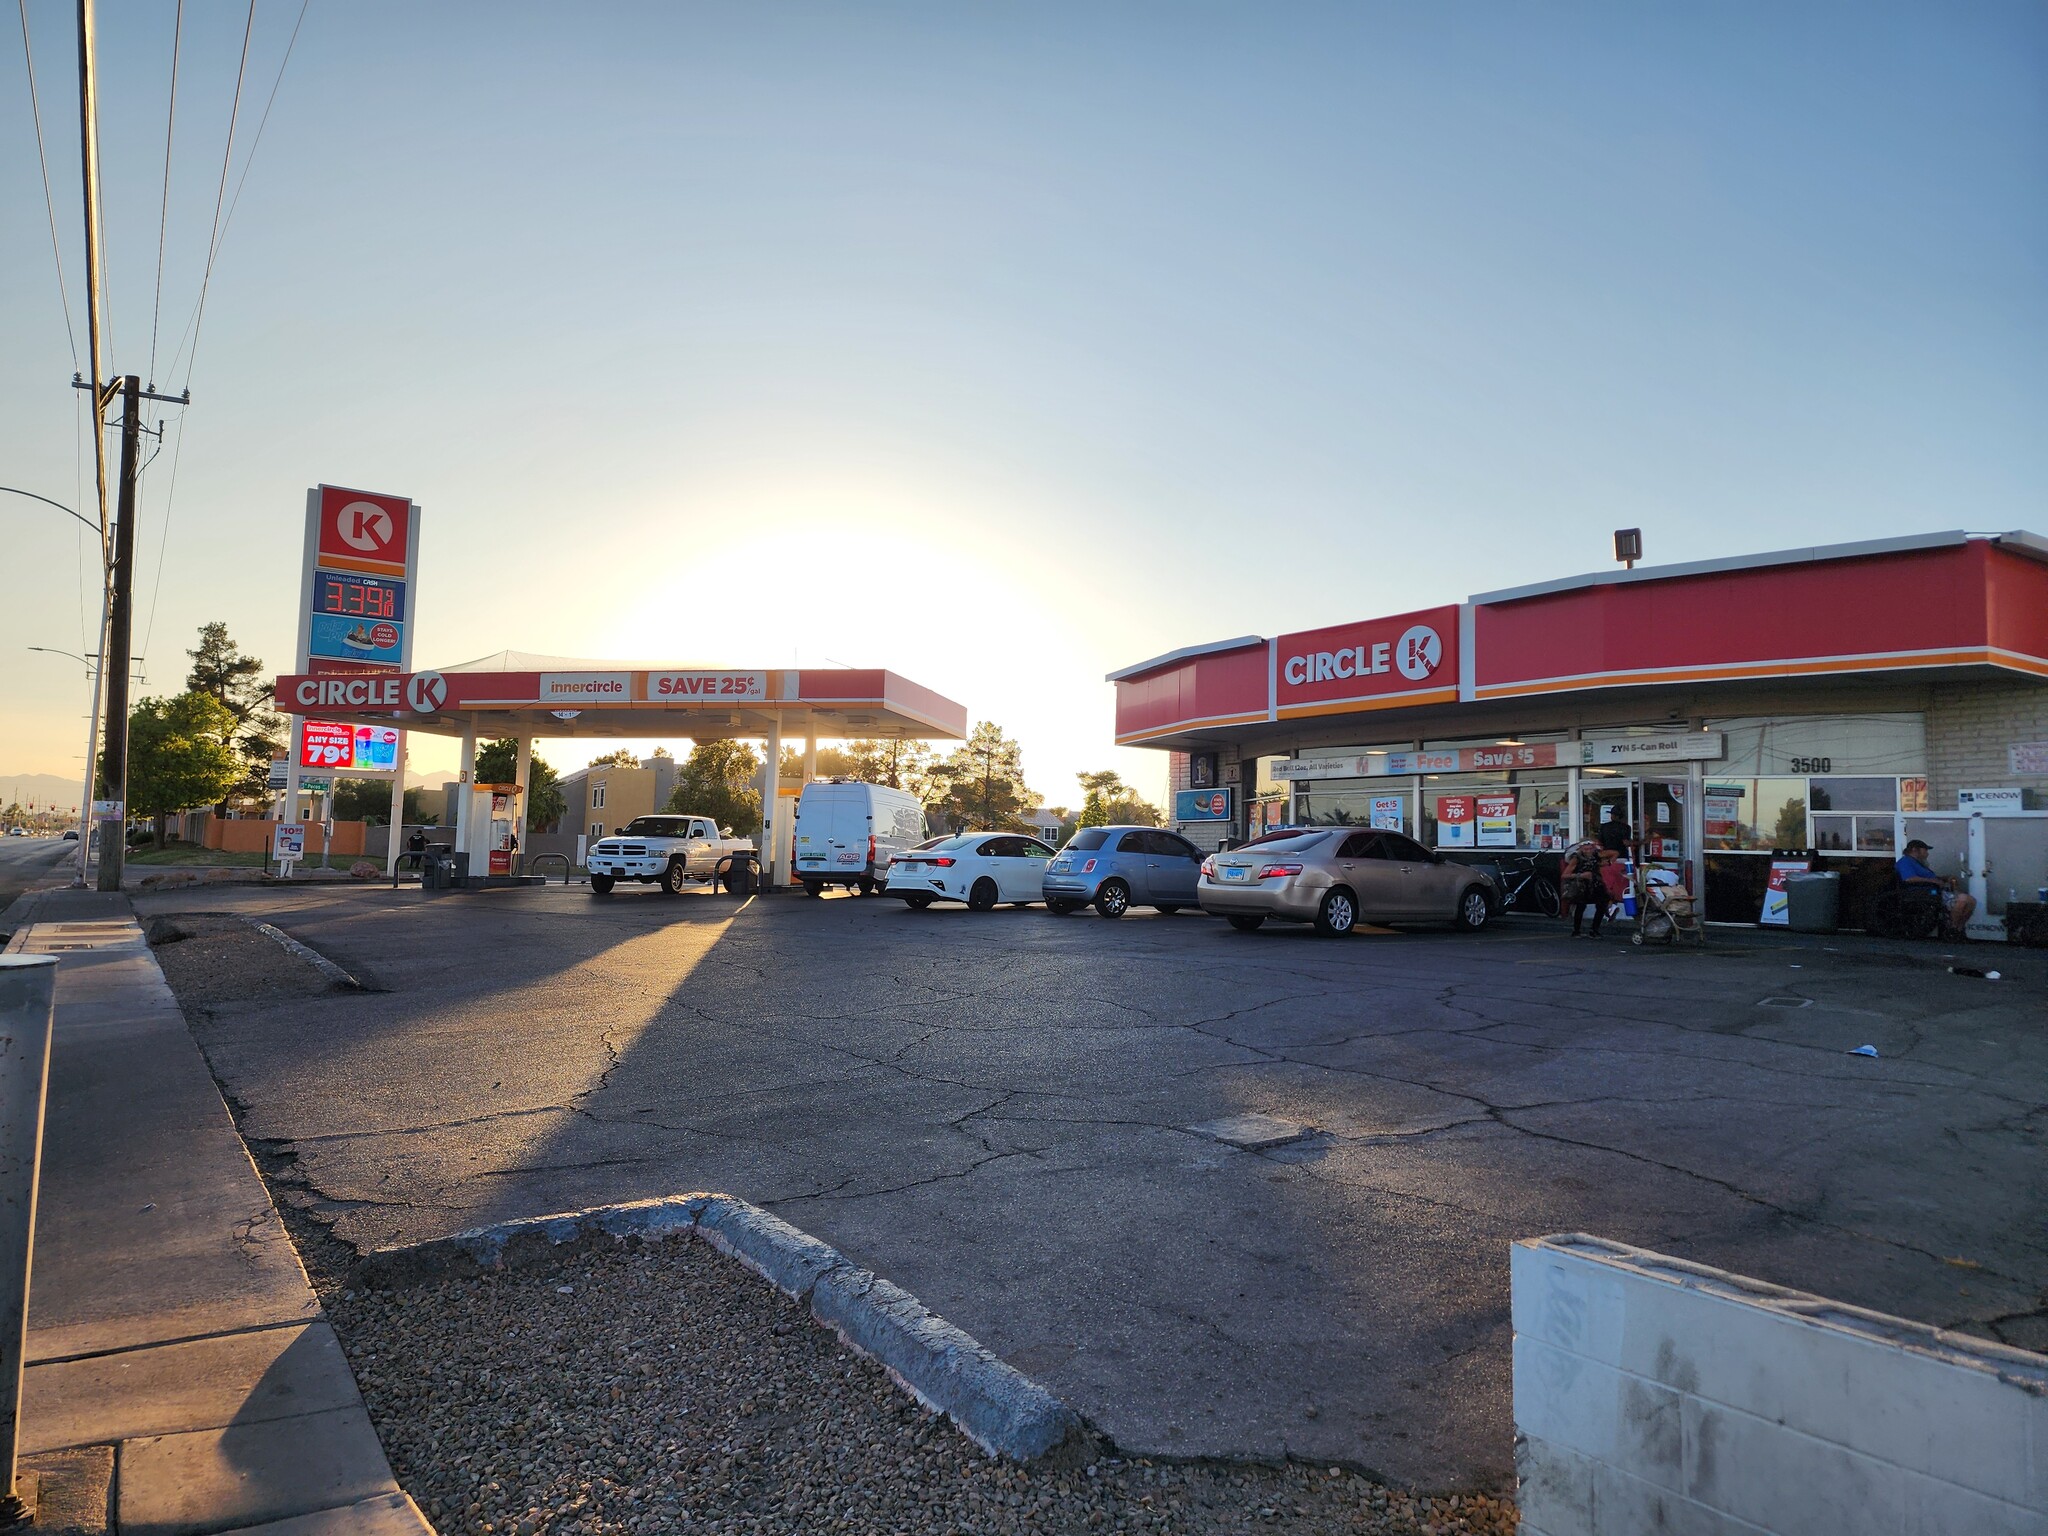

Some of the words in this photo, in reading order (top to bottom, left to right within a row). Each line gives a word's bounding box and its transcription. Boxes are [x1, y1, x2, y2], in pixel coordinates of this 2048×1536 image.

[352, 511, 388, 550] K
[326, 574, 361, 584] Unleaded
[363, 579, 378, 587] CASH
[326, 582, 383, 616] 3.39
[1284, 642, 1391, 686] CIRCLE
[1407, 634, 1438, 672] K
[551, 680, 623, 693] innercircle
[657, 677, 717, 695] SAVE
[720, 675, 755, 695] 25¢
[296, 679, 401, 706] CIRCLE
[416, 677, 444, 711] K
[306, 724, 342, 733] innercircle
[307, 735, 327, 744] ANY
[328, 737, 350, 745] SIZE
[1611, 744, 1630, 753] ZYN
[1658, 741, 1678, 750] Roll
[307, 744, 350, 764] 79¢
[1473, 751, 1514, 767] Save
[1517, 748, 1535, 765] $5
[1318, 761, 1344, 770] Varieties
[1417, 754, 1453, 769] Free
[1790, 757, 1832, 774] 3500
[1975, 791, 2020, 800] ICENOW
[1376, 800, 1389, 809] Get
[1389, 800, 1397, 808] $5
[1482, 805, 1509, 817] 3/$27
[1446, 808, 1465, 819] 79¢
